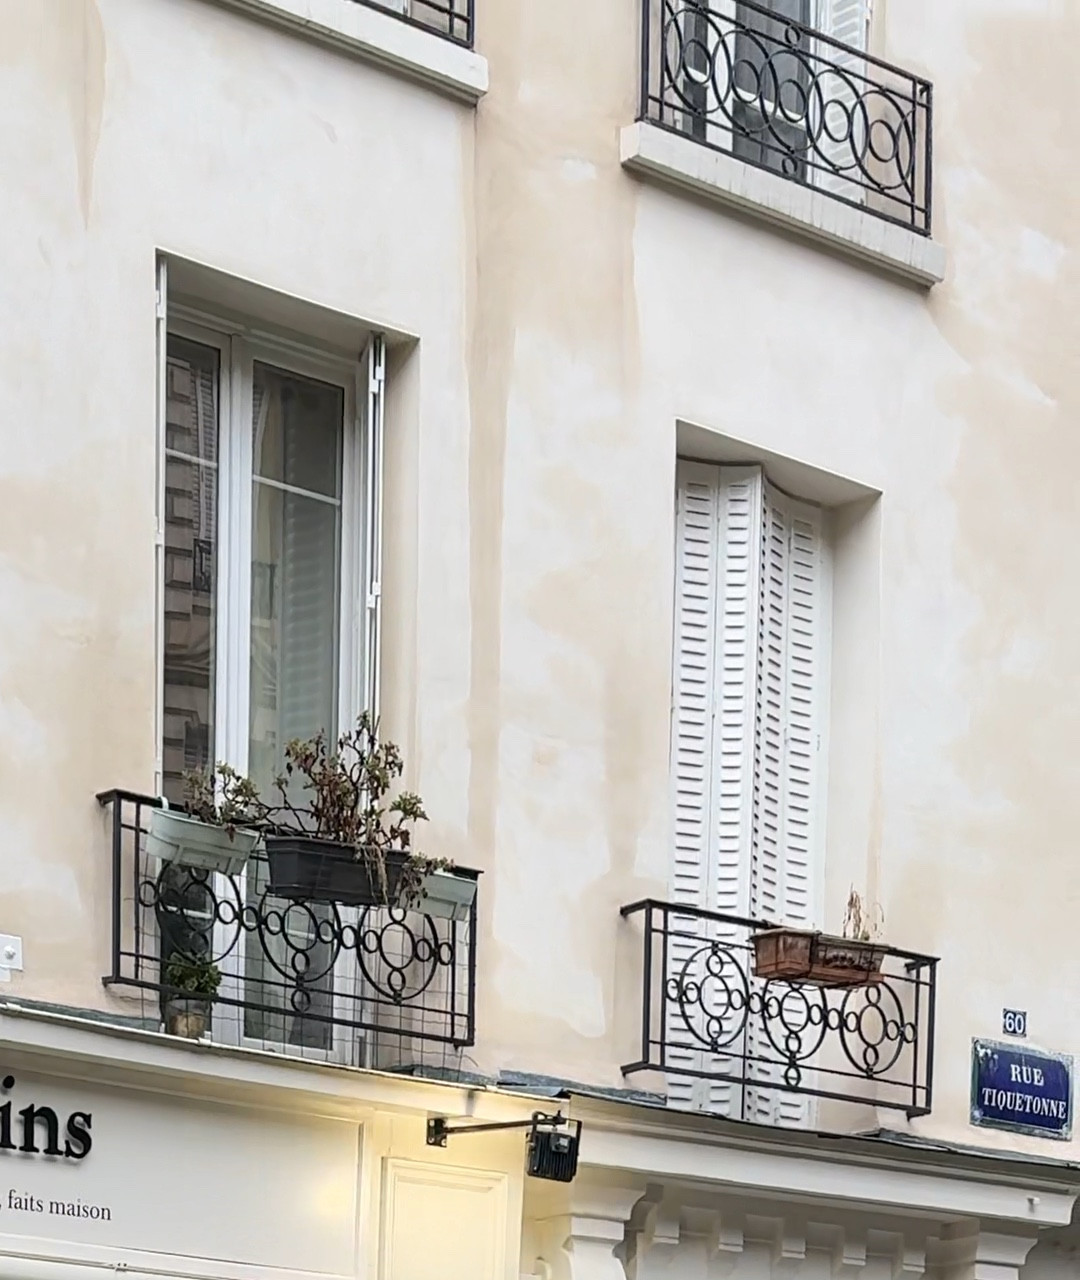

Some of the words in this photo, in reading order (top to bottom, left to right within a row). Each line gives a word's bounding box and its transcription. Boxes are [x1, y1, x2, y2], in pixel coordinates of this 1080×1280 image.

[1005, 1012, 1025, 1034] 60
[1010, 1064, 1045, 1086] RUE
[982, 1087, 1067, 1119] TIQUETONNE
[8, 1189, 44, 1213] faits
[48, 1198, 112, 1221] maison
